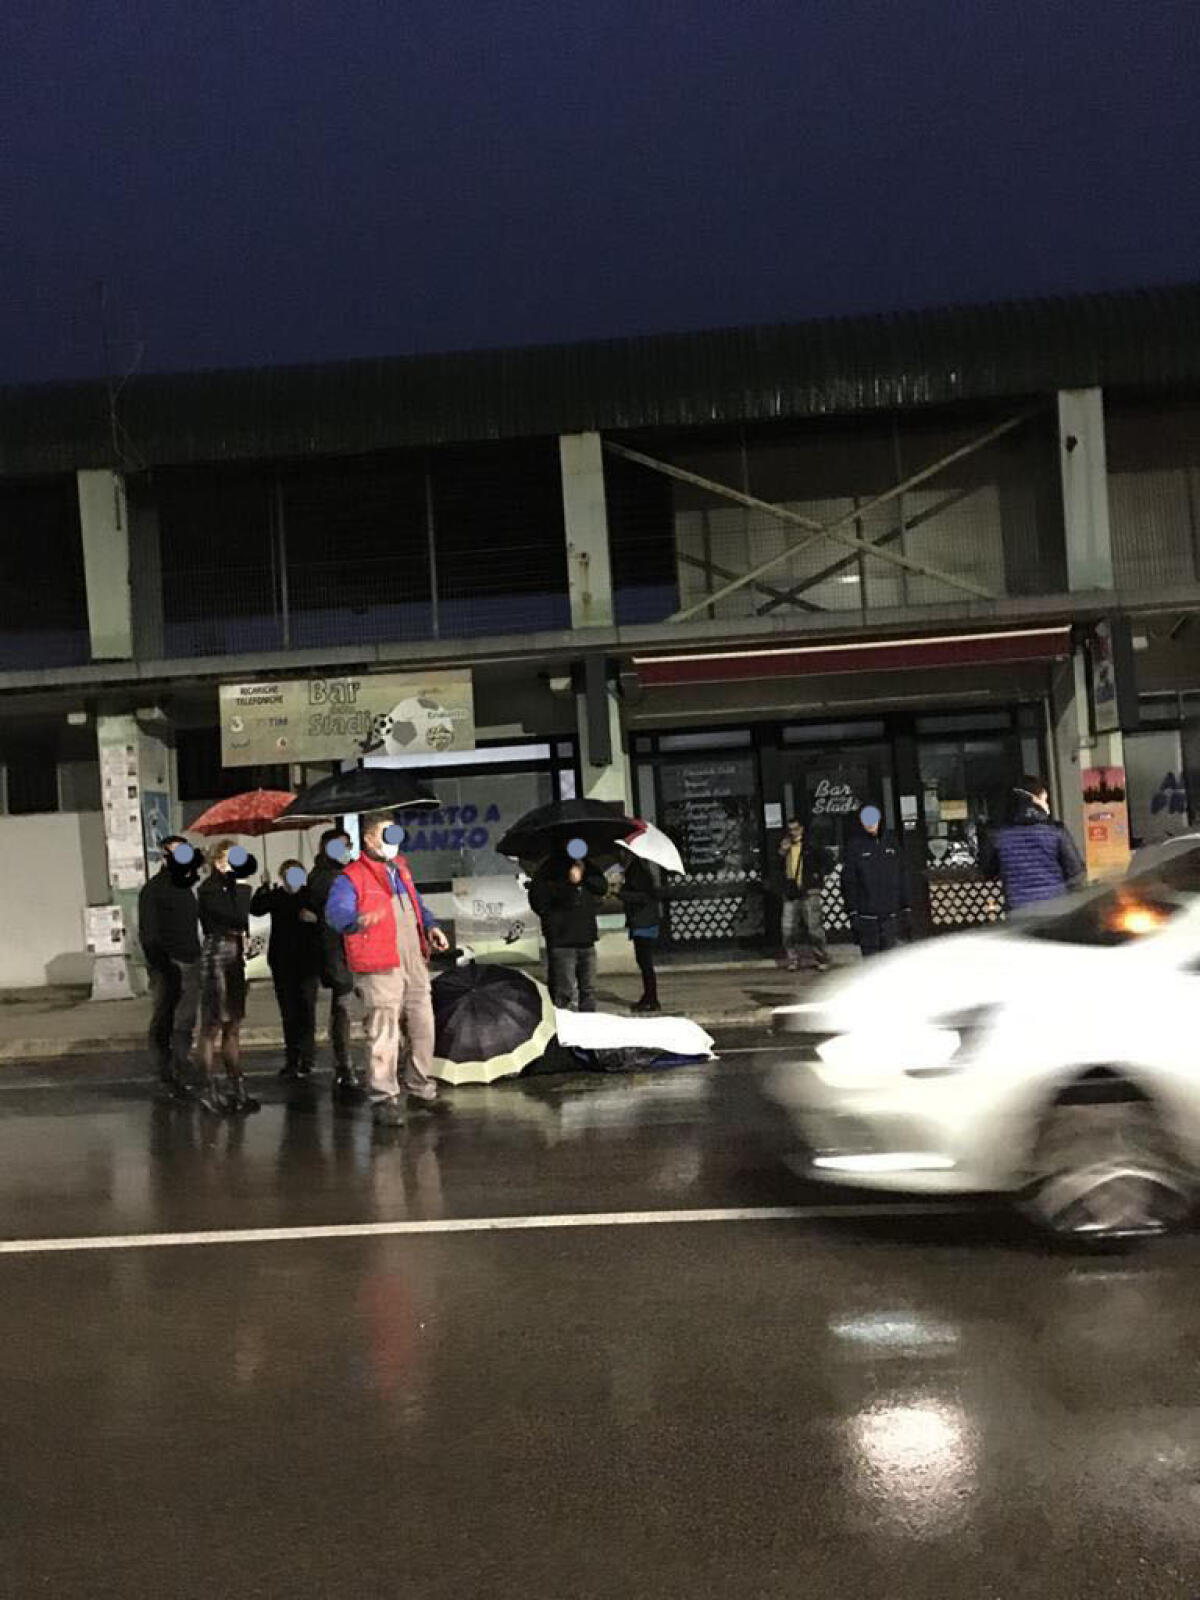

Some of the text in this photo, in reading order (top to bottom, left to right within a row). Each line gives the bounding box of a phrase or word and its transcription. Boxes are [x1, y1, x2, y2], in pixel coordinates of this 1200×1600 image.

[308, 679, 361, 706] Bar
[813, 779, 852, 798] Bar
[485, 803, 501, 824] A
[472, 899, 504, 916] Bar
